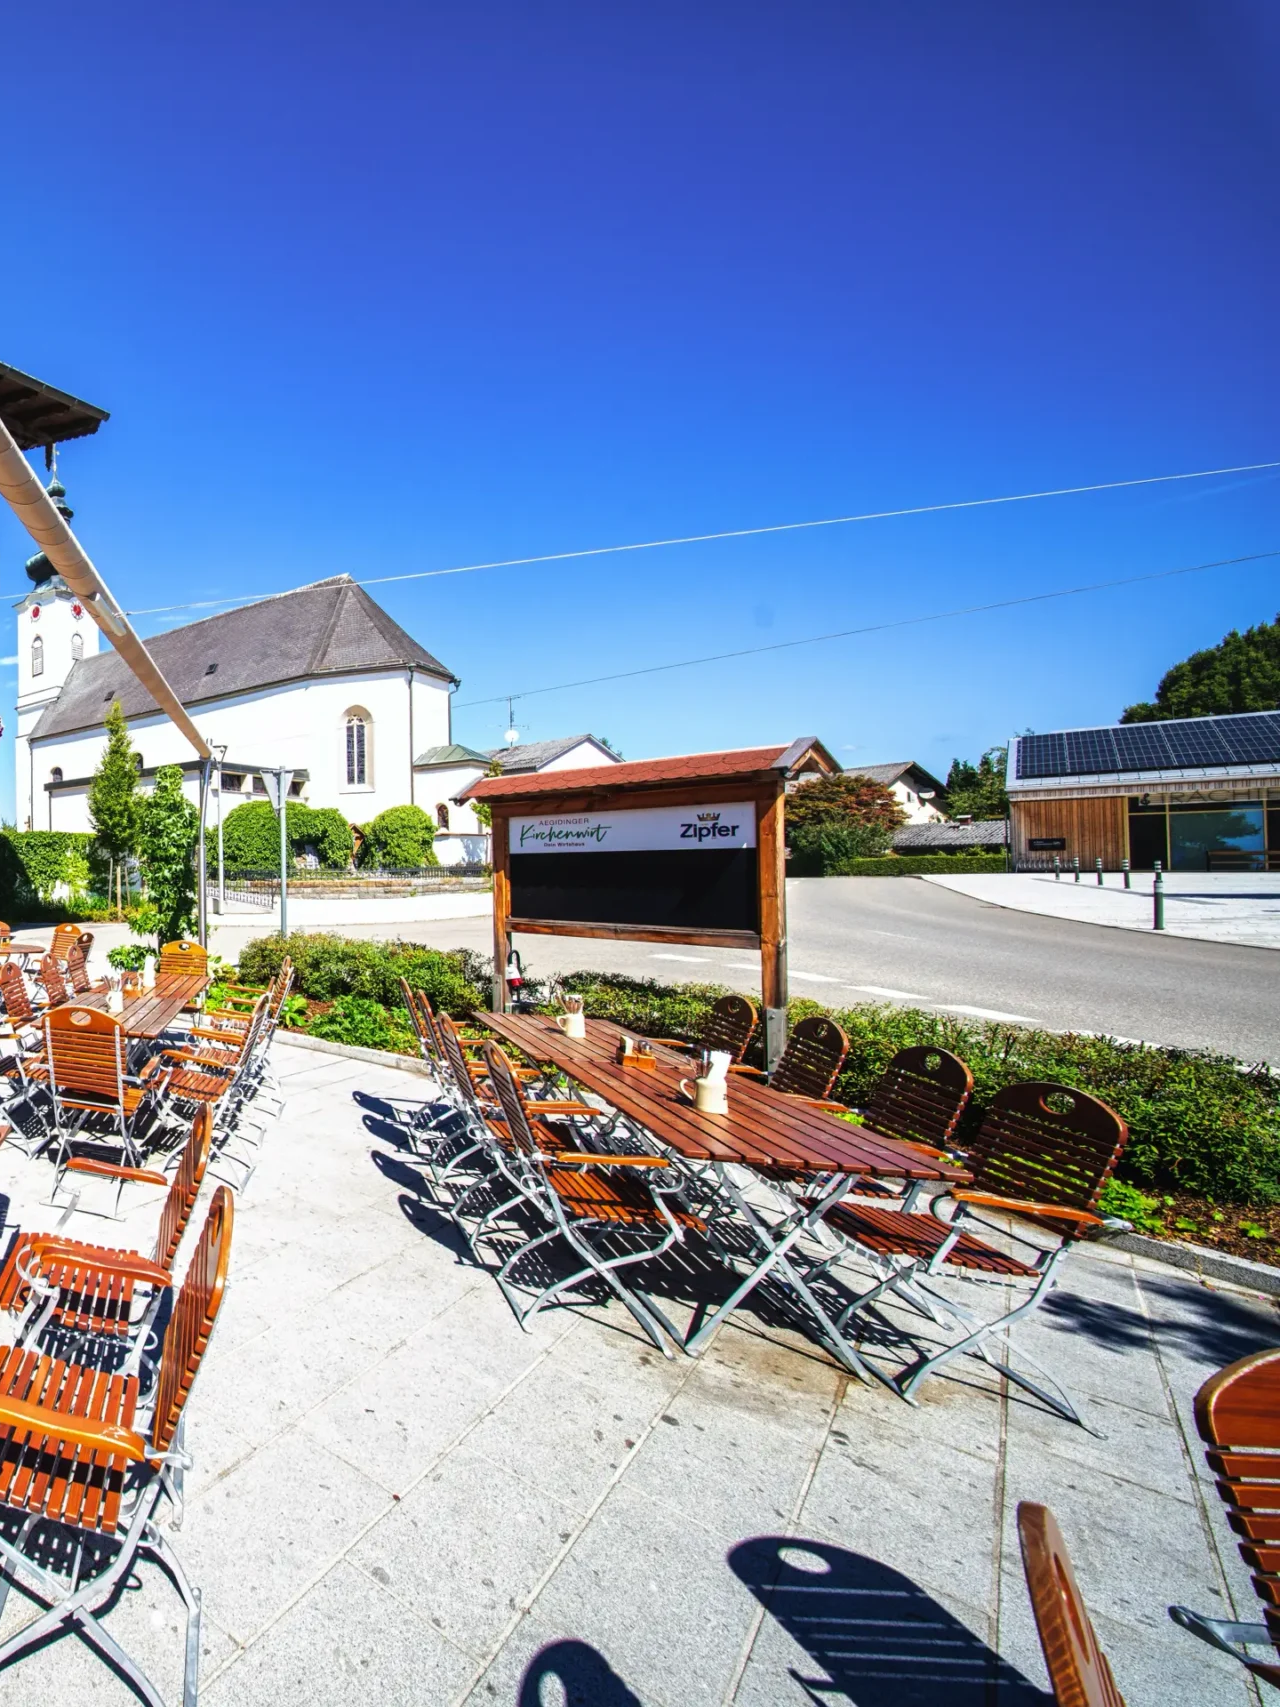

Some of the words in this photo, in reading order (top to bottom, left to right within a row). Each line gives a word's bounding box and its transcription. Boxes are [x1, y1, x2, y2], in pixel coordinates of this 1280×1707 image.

[539, 818, 589, 826] AEGIDINGER
[680, 822, 740, 842] Zipfer
[520, 824, 612, 847] Kirchenwirt
